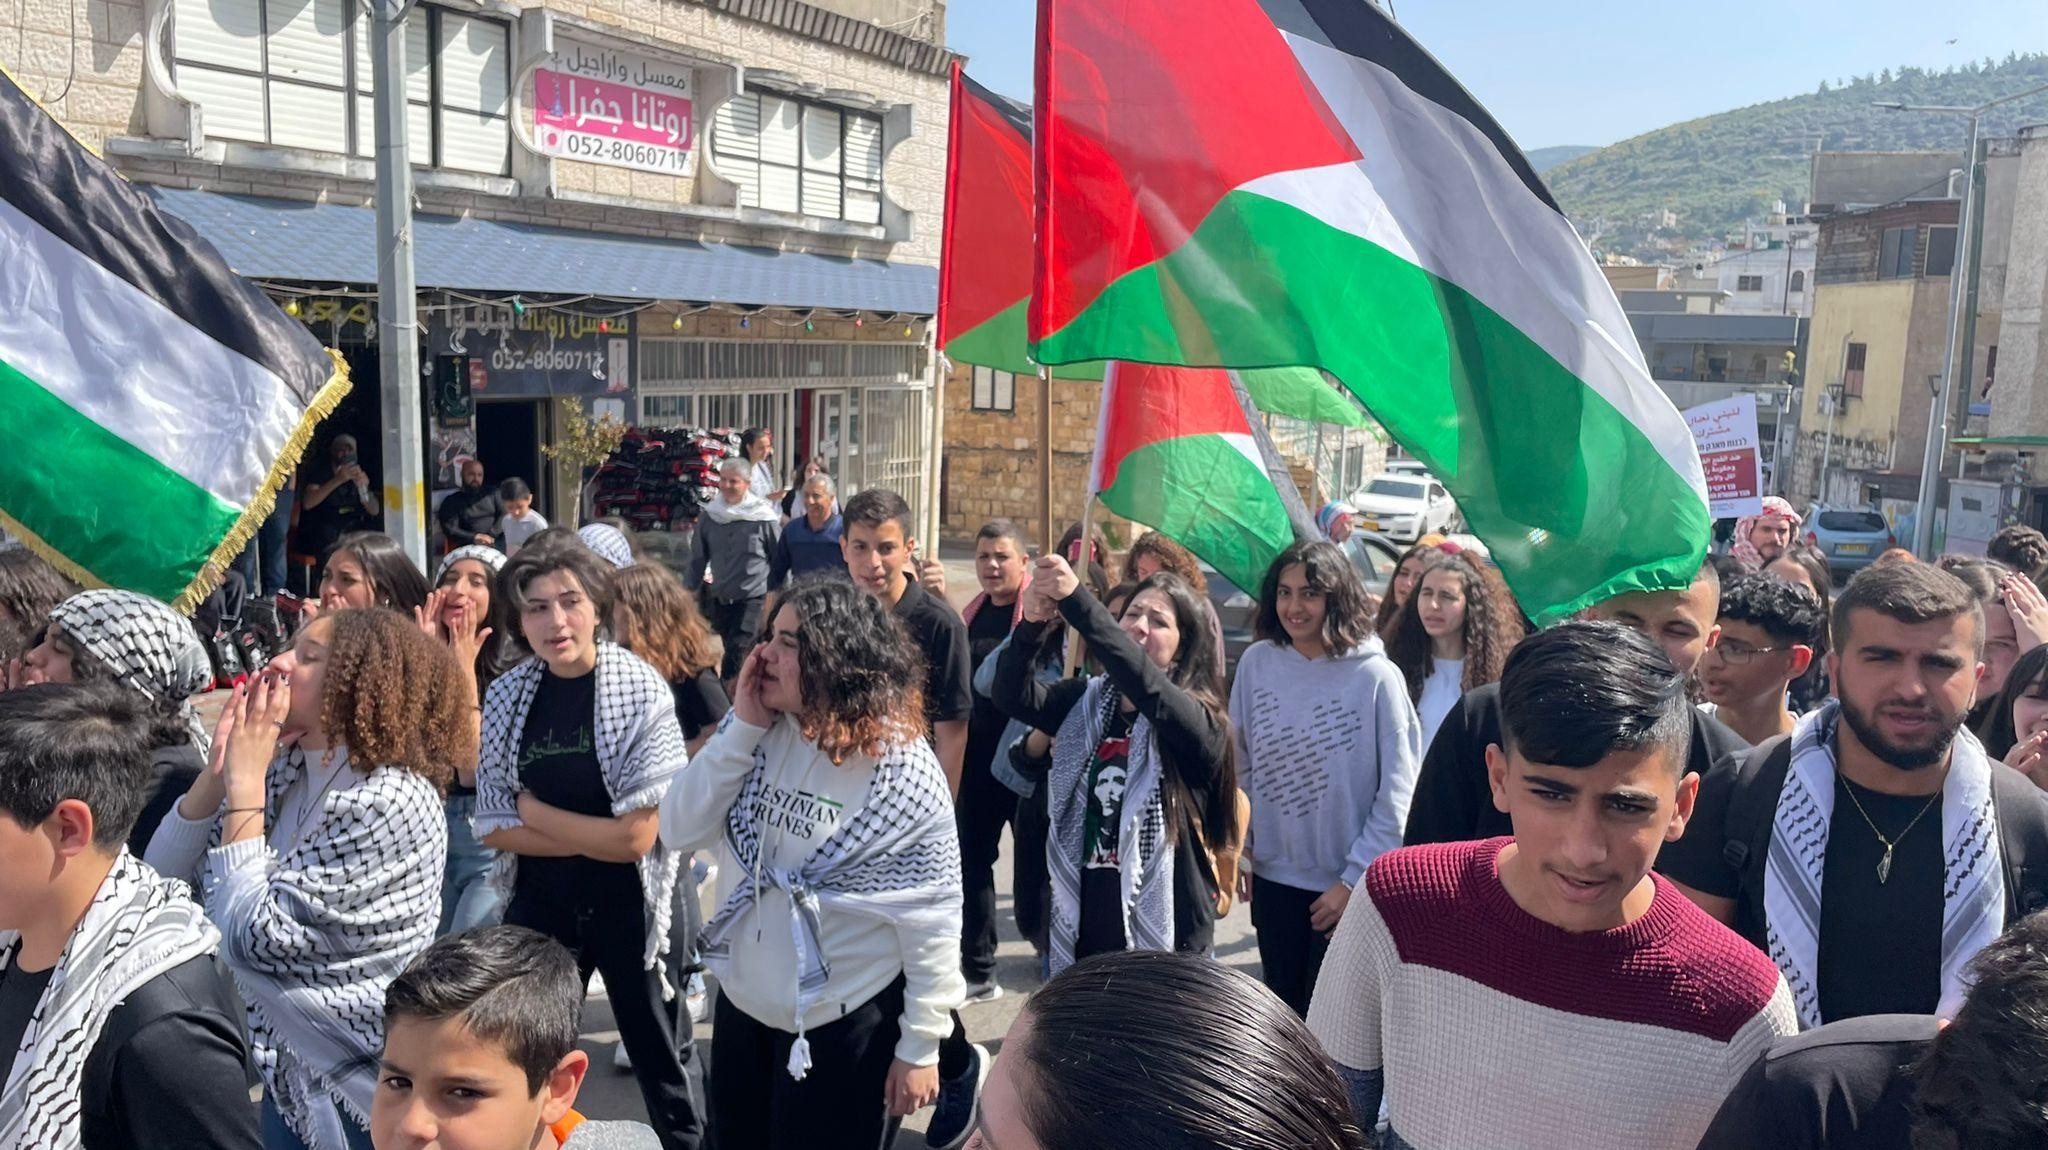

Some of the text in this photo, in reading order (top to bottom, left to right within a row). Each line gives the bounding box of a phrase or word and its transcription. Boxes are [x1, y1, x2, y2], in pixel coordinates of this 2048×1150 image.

[634, 61, 686, 90] معسل
[567, 79, 688, 145] روتانا جفرا
[567, 134, 688, 171] 052-8060717
[492, 350, 602, 372] 052-8060717
[754, 802, 816, 840] RLINES
[759, 783, 841, 825] ESTINIAN
